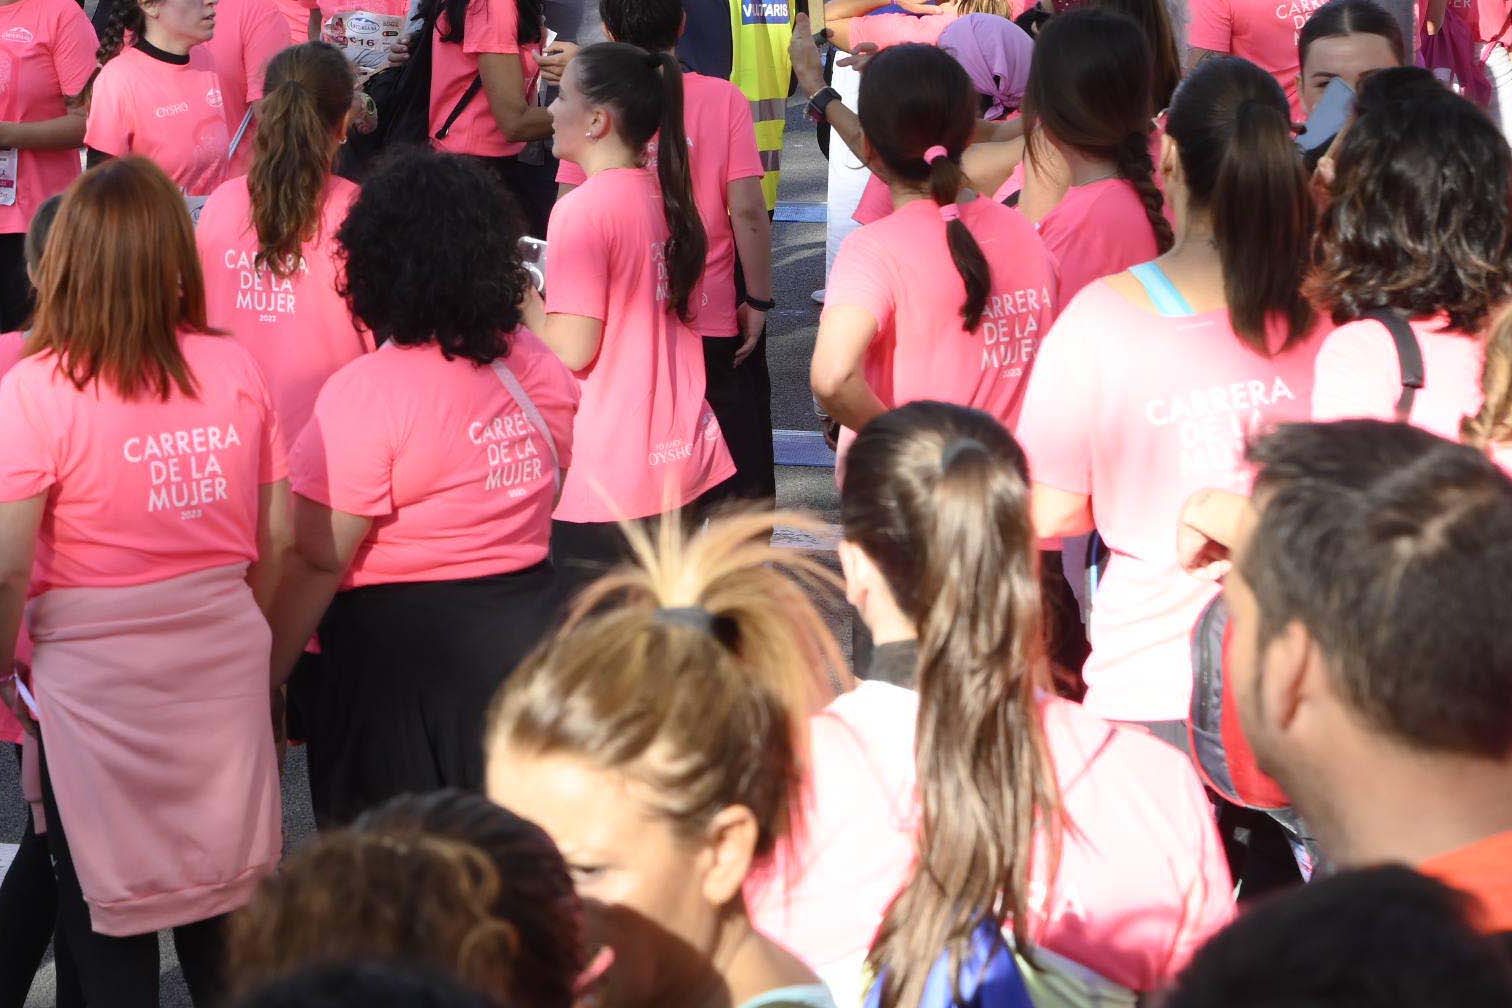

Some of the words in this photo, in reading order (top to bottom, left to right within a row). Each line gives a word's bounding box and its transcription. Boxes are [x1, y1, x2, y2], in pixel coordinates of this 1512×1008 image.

[240, 270, 264, 291] DE
[271, 272, 294, 292] LA
[236, 290, 296, 314] MUJER
[981, 286, 1052, 319] ARRERA
[983, 319, 1010, 346] DE
[1014, 313, 1038, 338] LA
[1144, 376, 1297, 426] CARRERA
[123, 423, 241, 464] CARRERA
[488, 440, 512, 467] DE
[516, 438, 538, 460] LA
[150, 458, 183, 486] DE
[190, 452, 223, 480] LA
[484, 458, 542, 491] MUJER
[148, 476, 228, 513] MUJER
